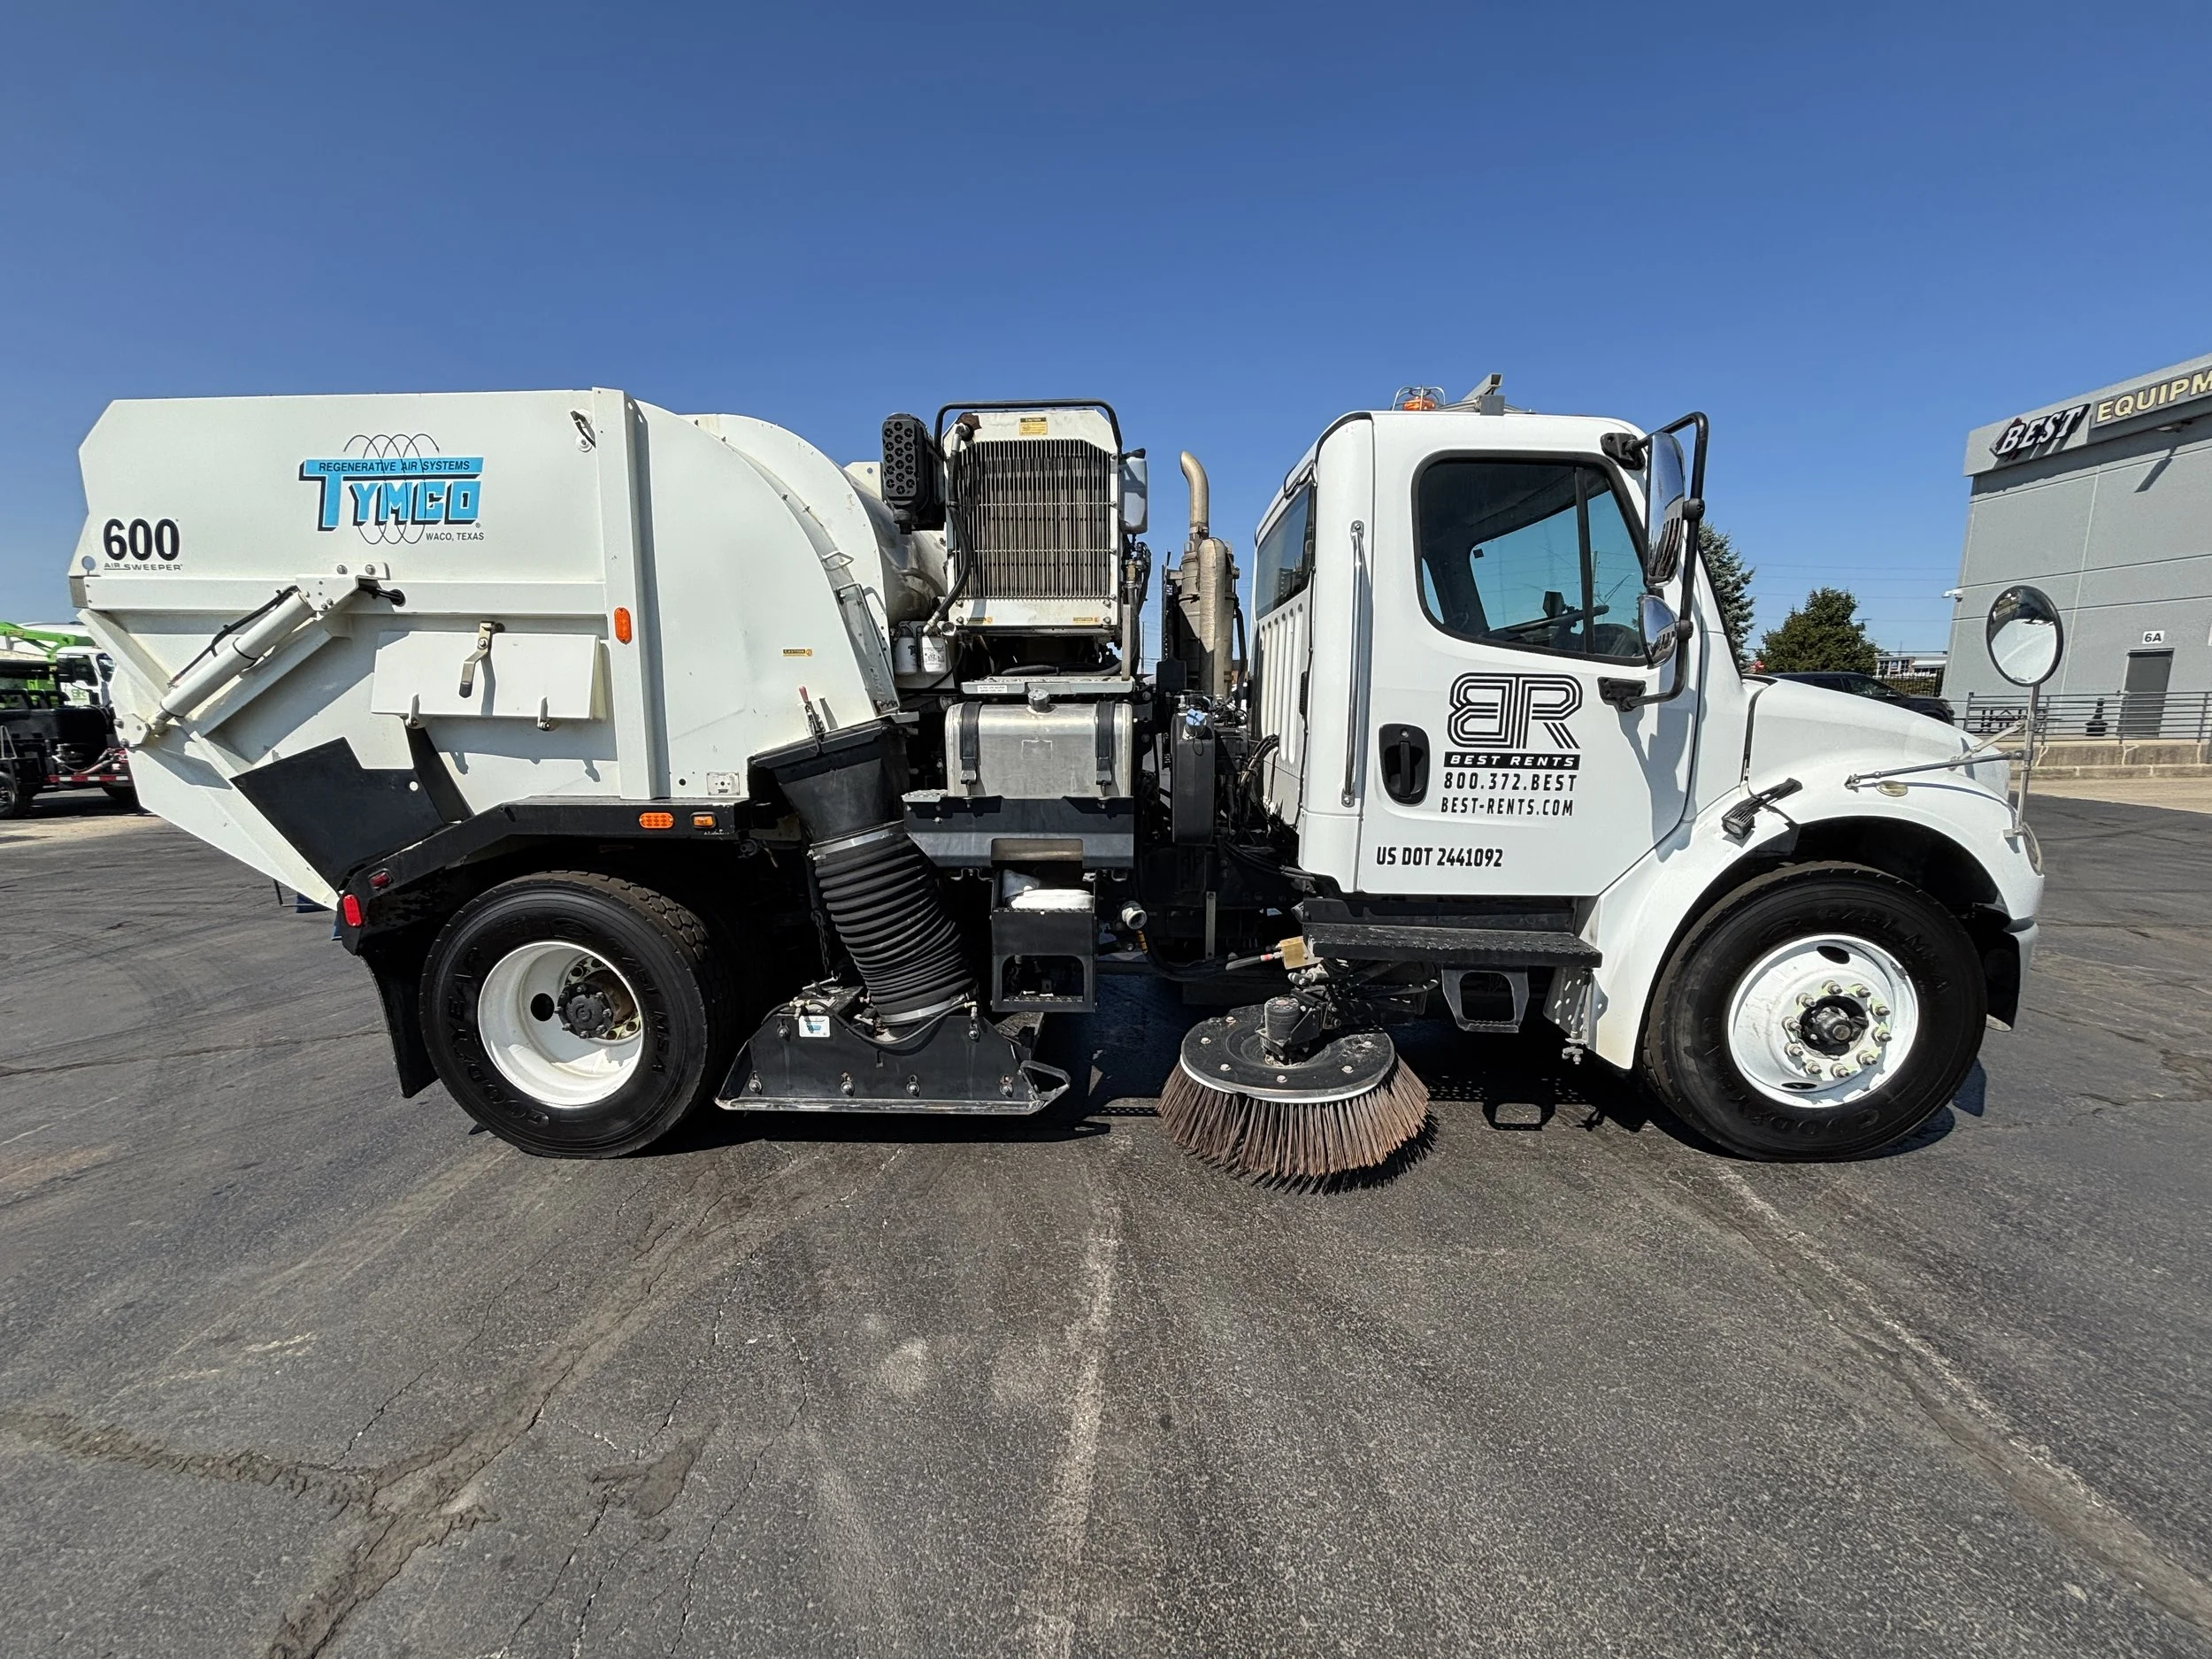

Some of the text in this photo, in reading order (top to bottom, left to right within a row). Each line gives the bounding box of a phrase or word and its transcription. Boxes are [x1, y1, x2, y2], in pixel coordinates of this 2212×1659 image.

[1995, 404, 2085, 455] BEST
[319, 461, 471, 472] REGENERATIVE AIR SYSTEMS
[299, 457, 483, 531] TYMCO
[104, 518, 180, 561] 600
[426, 532, 485, 541] WACO, TEXAS
[2145, 633, 2162, 642] 6A
[1450, 755, 1575, 767] BEST RENTS
[1443, 772, 1577, 792] 800.372.BEST
[1441, 797, 1573, 816] BEST-RENTS.COM
[1376, 847, 1503, 867] US DOT 2441092
